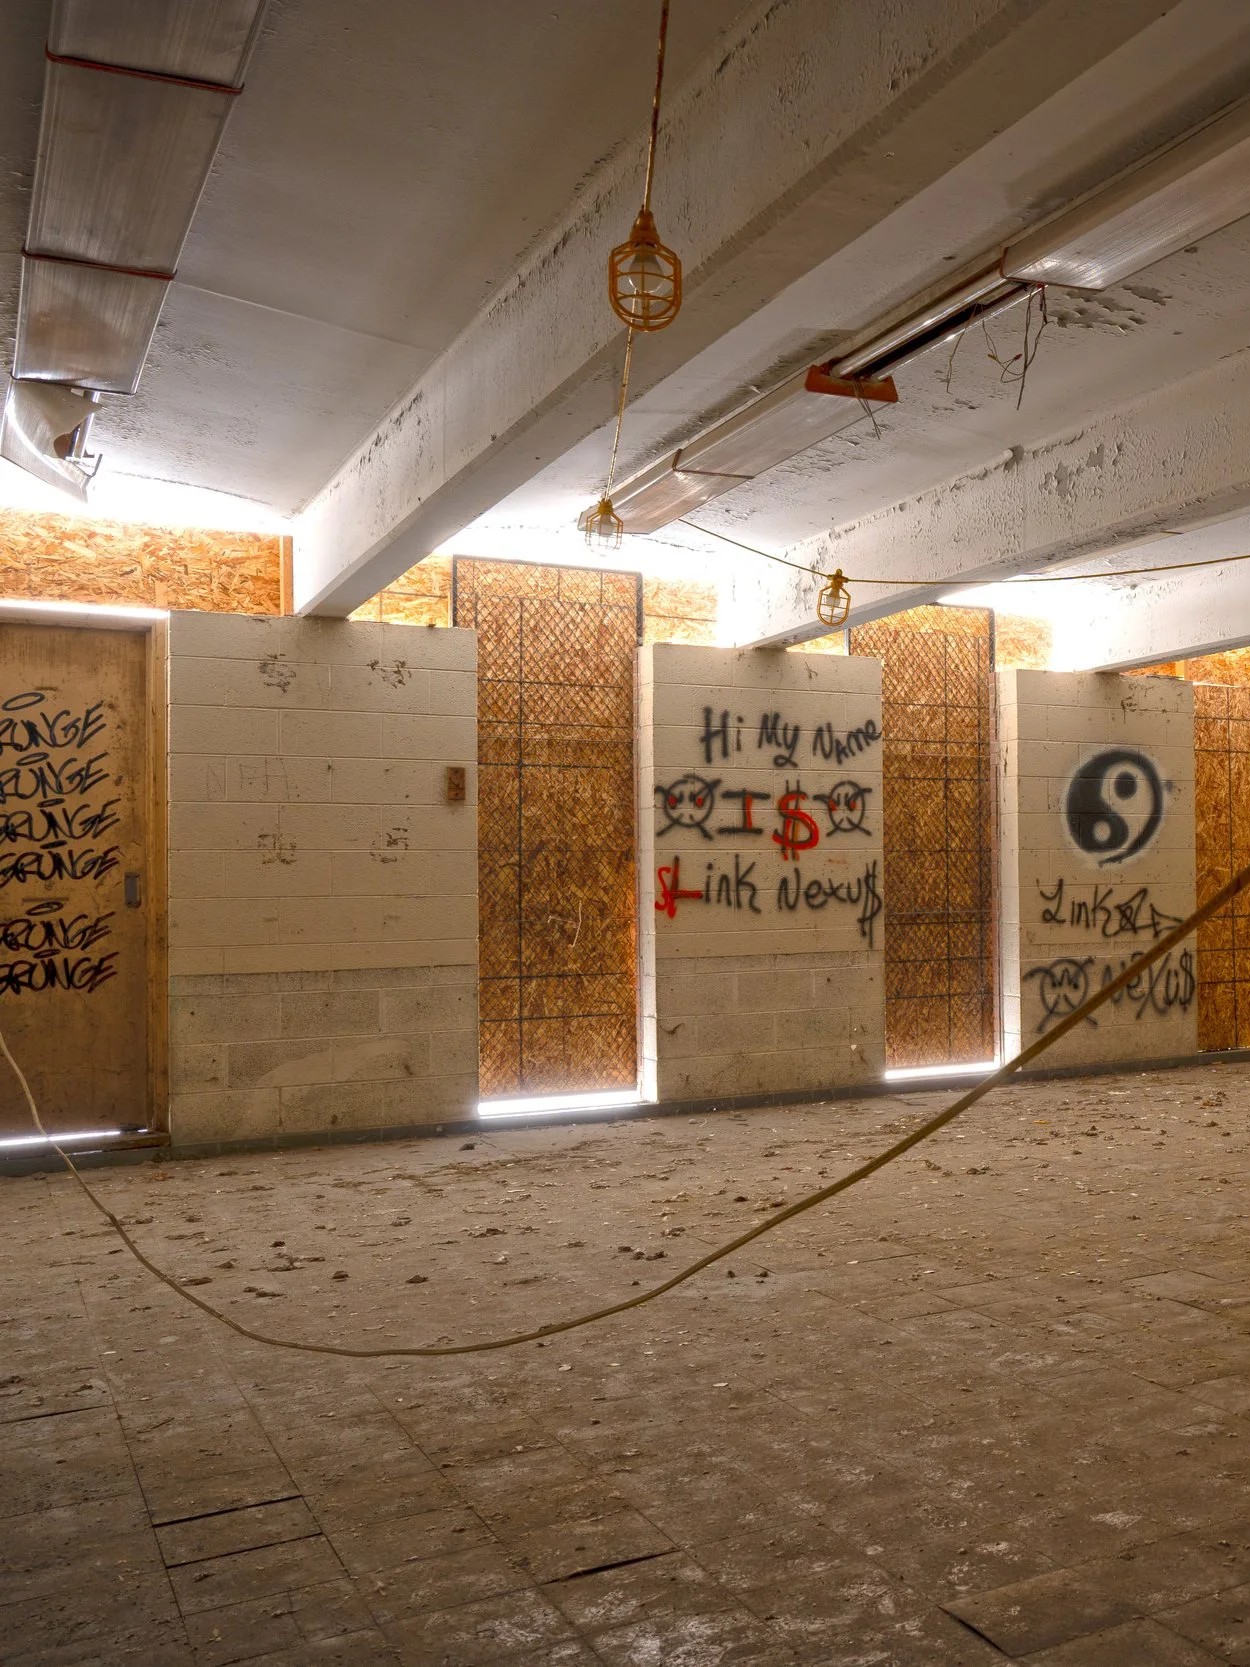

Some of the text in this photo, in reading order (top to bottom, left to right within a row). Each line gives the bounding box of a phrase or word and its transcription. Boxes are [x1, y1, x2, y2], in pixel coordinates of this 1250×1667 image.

[699, 706, 745, 764] Hi
[757, 712, 799, 768] My
[0, 911, 116, 951] RUNGE
